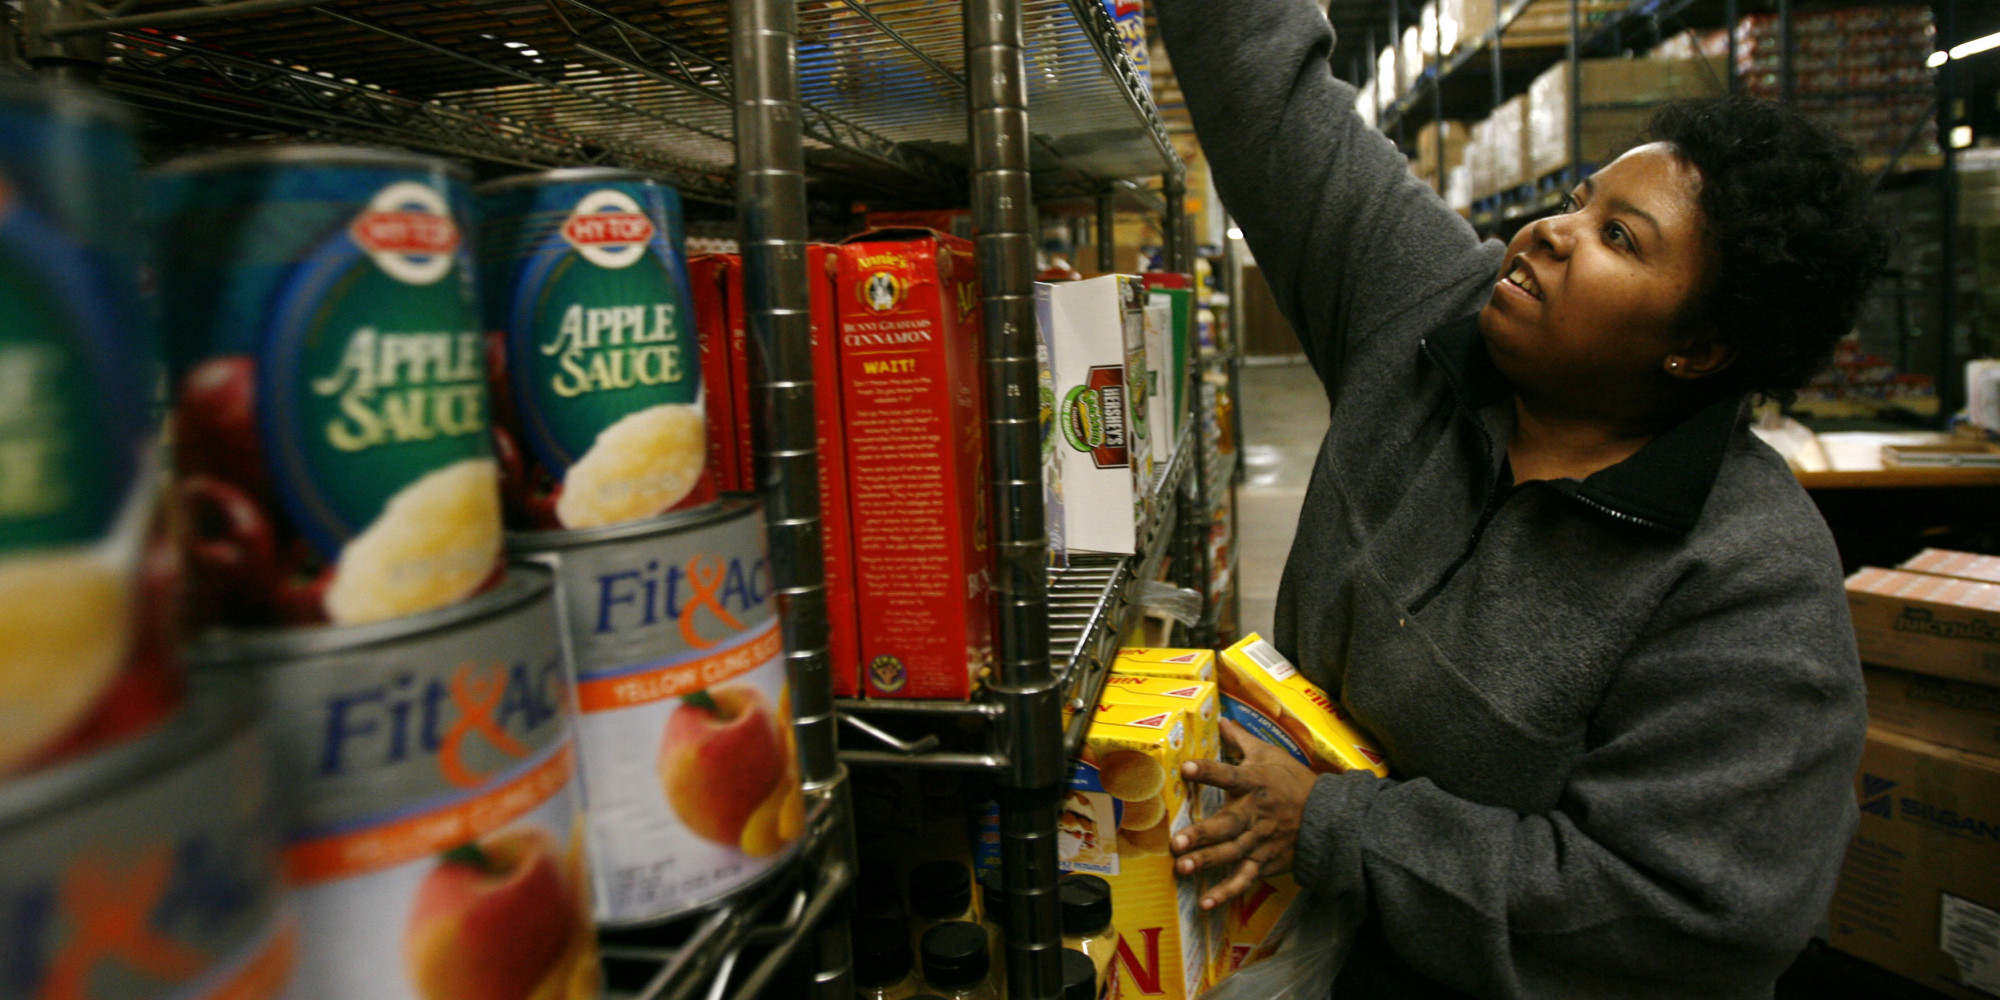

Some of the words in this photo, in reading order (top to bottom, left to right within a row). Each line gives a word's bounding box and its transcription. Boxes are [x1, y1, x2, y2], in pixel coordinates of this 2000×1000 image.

[857, 252, 907, 271] Annie's
[541, 303, 677, 356] APPLE
[844, 330, 932, 346] CINNAMON
[552, 345, 683, 398] SAUCE
[863, 359, 916, 374] WAIT!
[1103, 387, 1124, 446] HERSHEY'S
[613, 667, 698, 703] YELLOW
[701, 652, 751, 683] CLING
[1901, 798, 2000, 841] SILGAN
